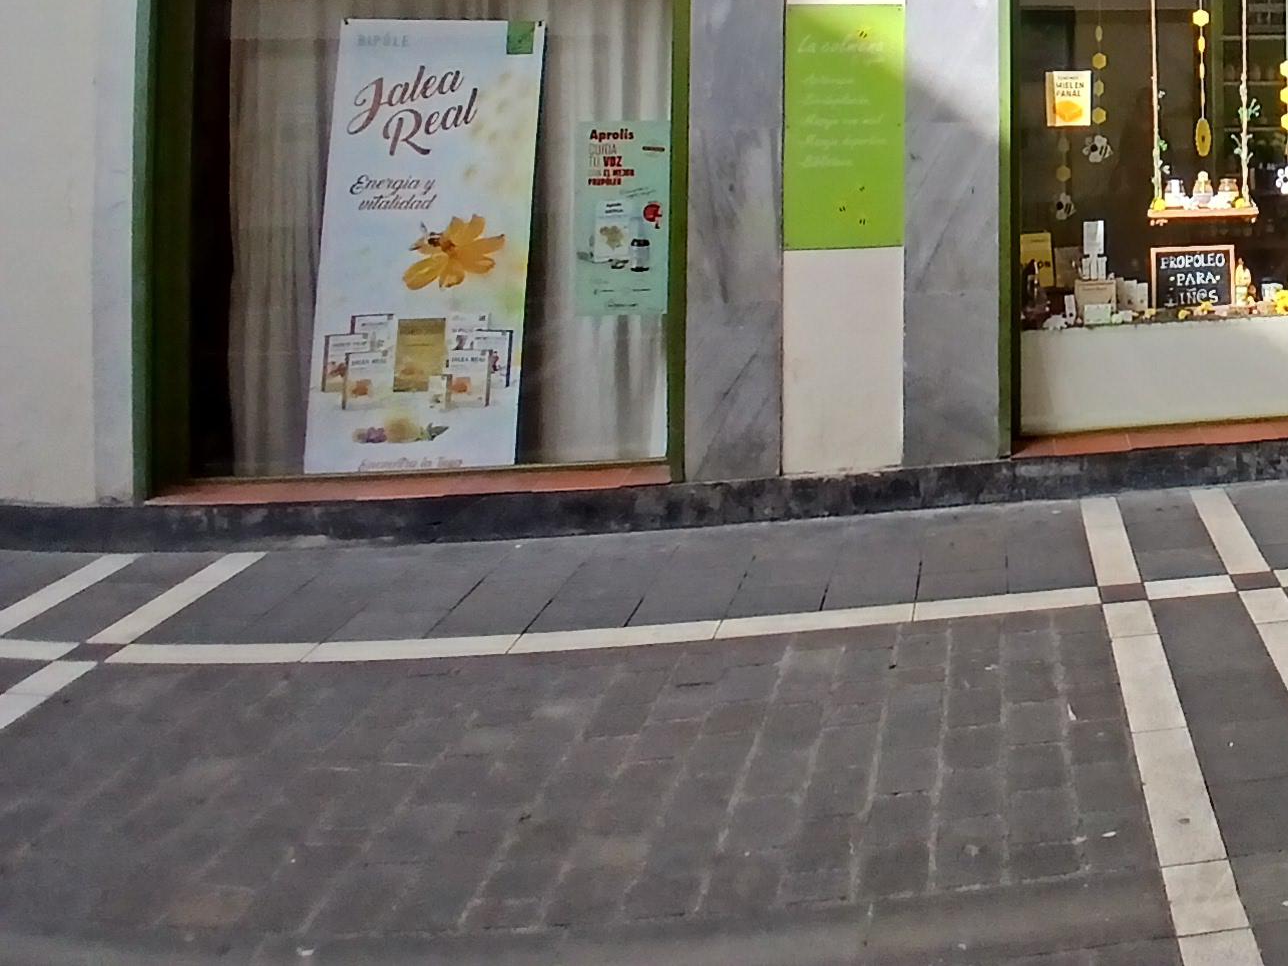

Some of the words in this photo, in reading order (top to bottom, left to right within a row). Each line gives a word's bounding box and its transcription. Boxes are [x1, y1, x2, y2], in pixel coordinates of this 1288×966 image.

[346, 65, 466, 135] Jalea
[383, 87, 479, 156] Real
[589, 128, 635, 142] Aprolis
[358, 194, 438, 210] vitalidad
